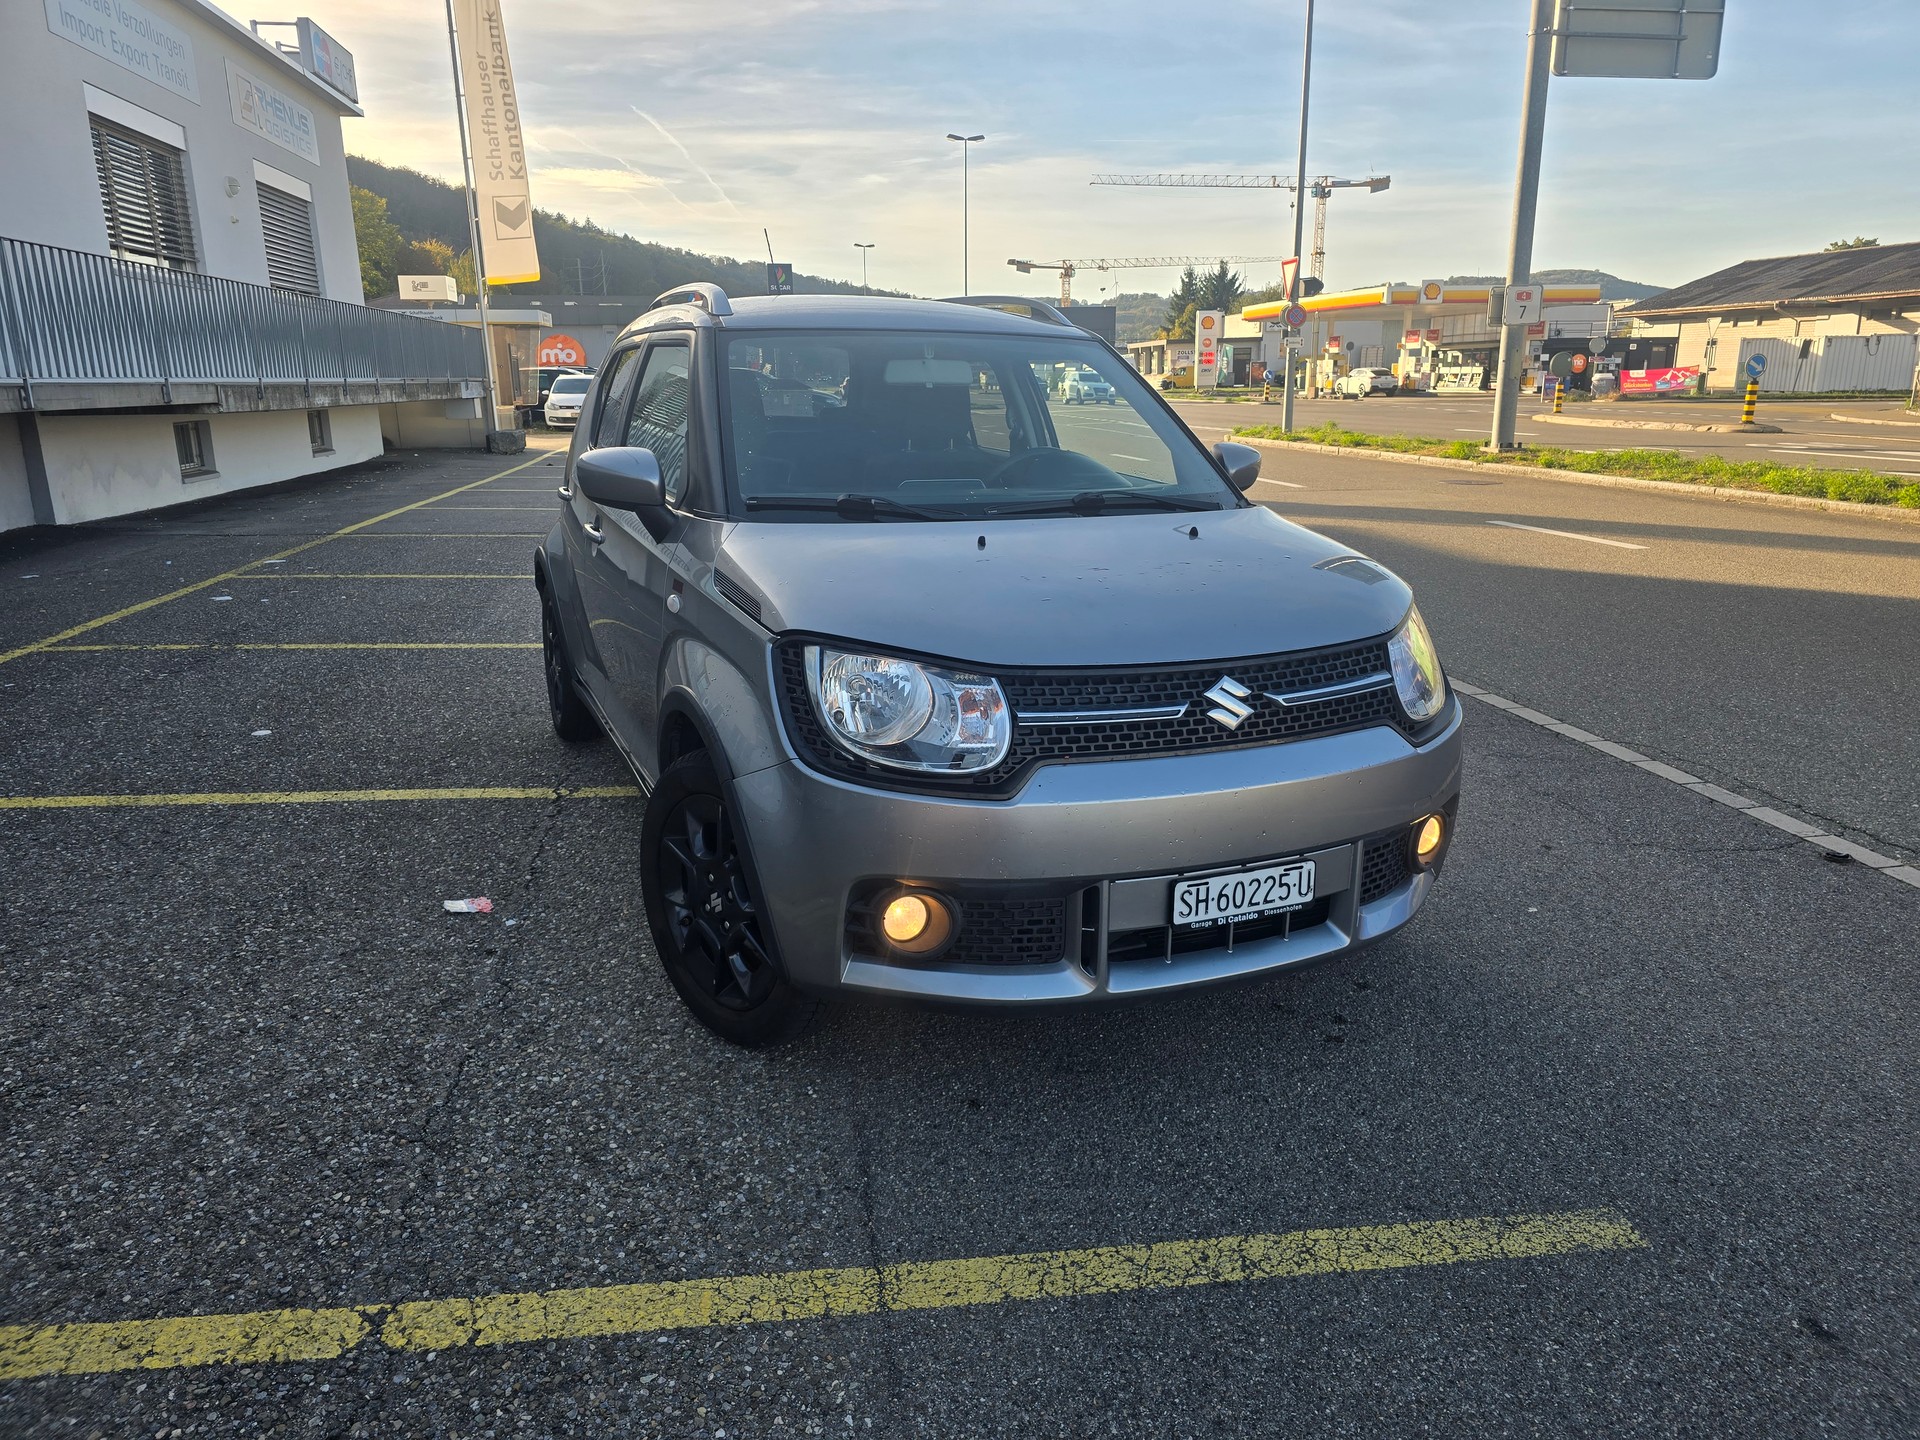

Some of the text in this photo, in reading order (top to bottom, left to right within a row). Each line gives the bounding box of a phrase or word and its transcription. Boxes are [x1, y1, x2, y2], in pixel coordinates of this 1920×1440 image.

[58, 2, 191, 92] Import Export Transit
[113, 0, 186, 60] Verzollungen
[254, 85, 310, 136] RHENUS
[476, 51, 505, 181] Schaffhauser
[483, 10, 525, 180] Kantonalbank
[1519, 305, 1527, 319] 7
[1521, 292, 1527, 300] 4
[541, 342, 577, 363] mio
[1190, 904, 1303, 929] Garage Di Cataldo Diessenhofen
